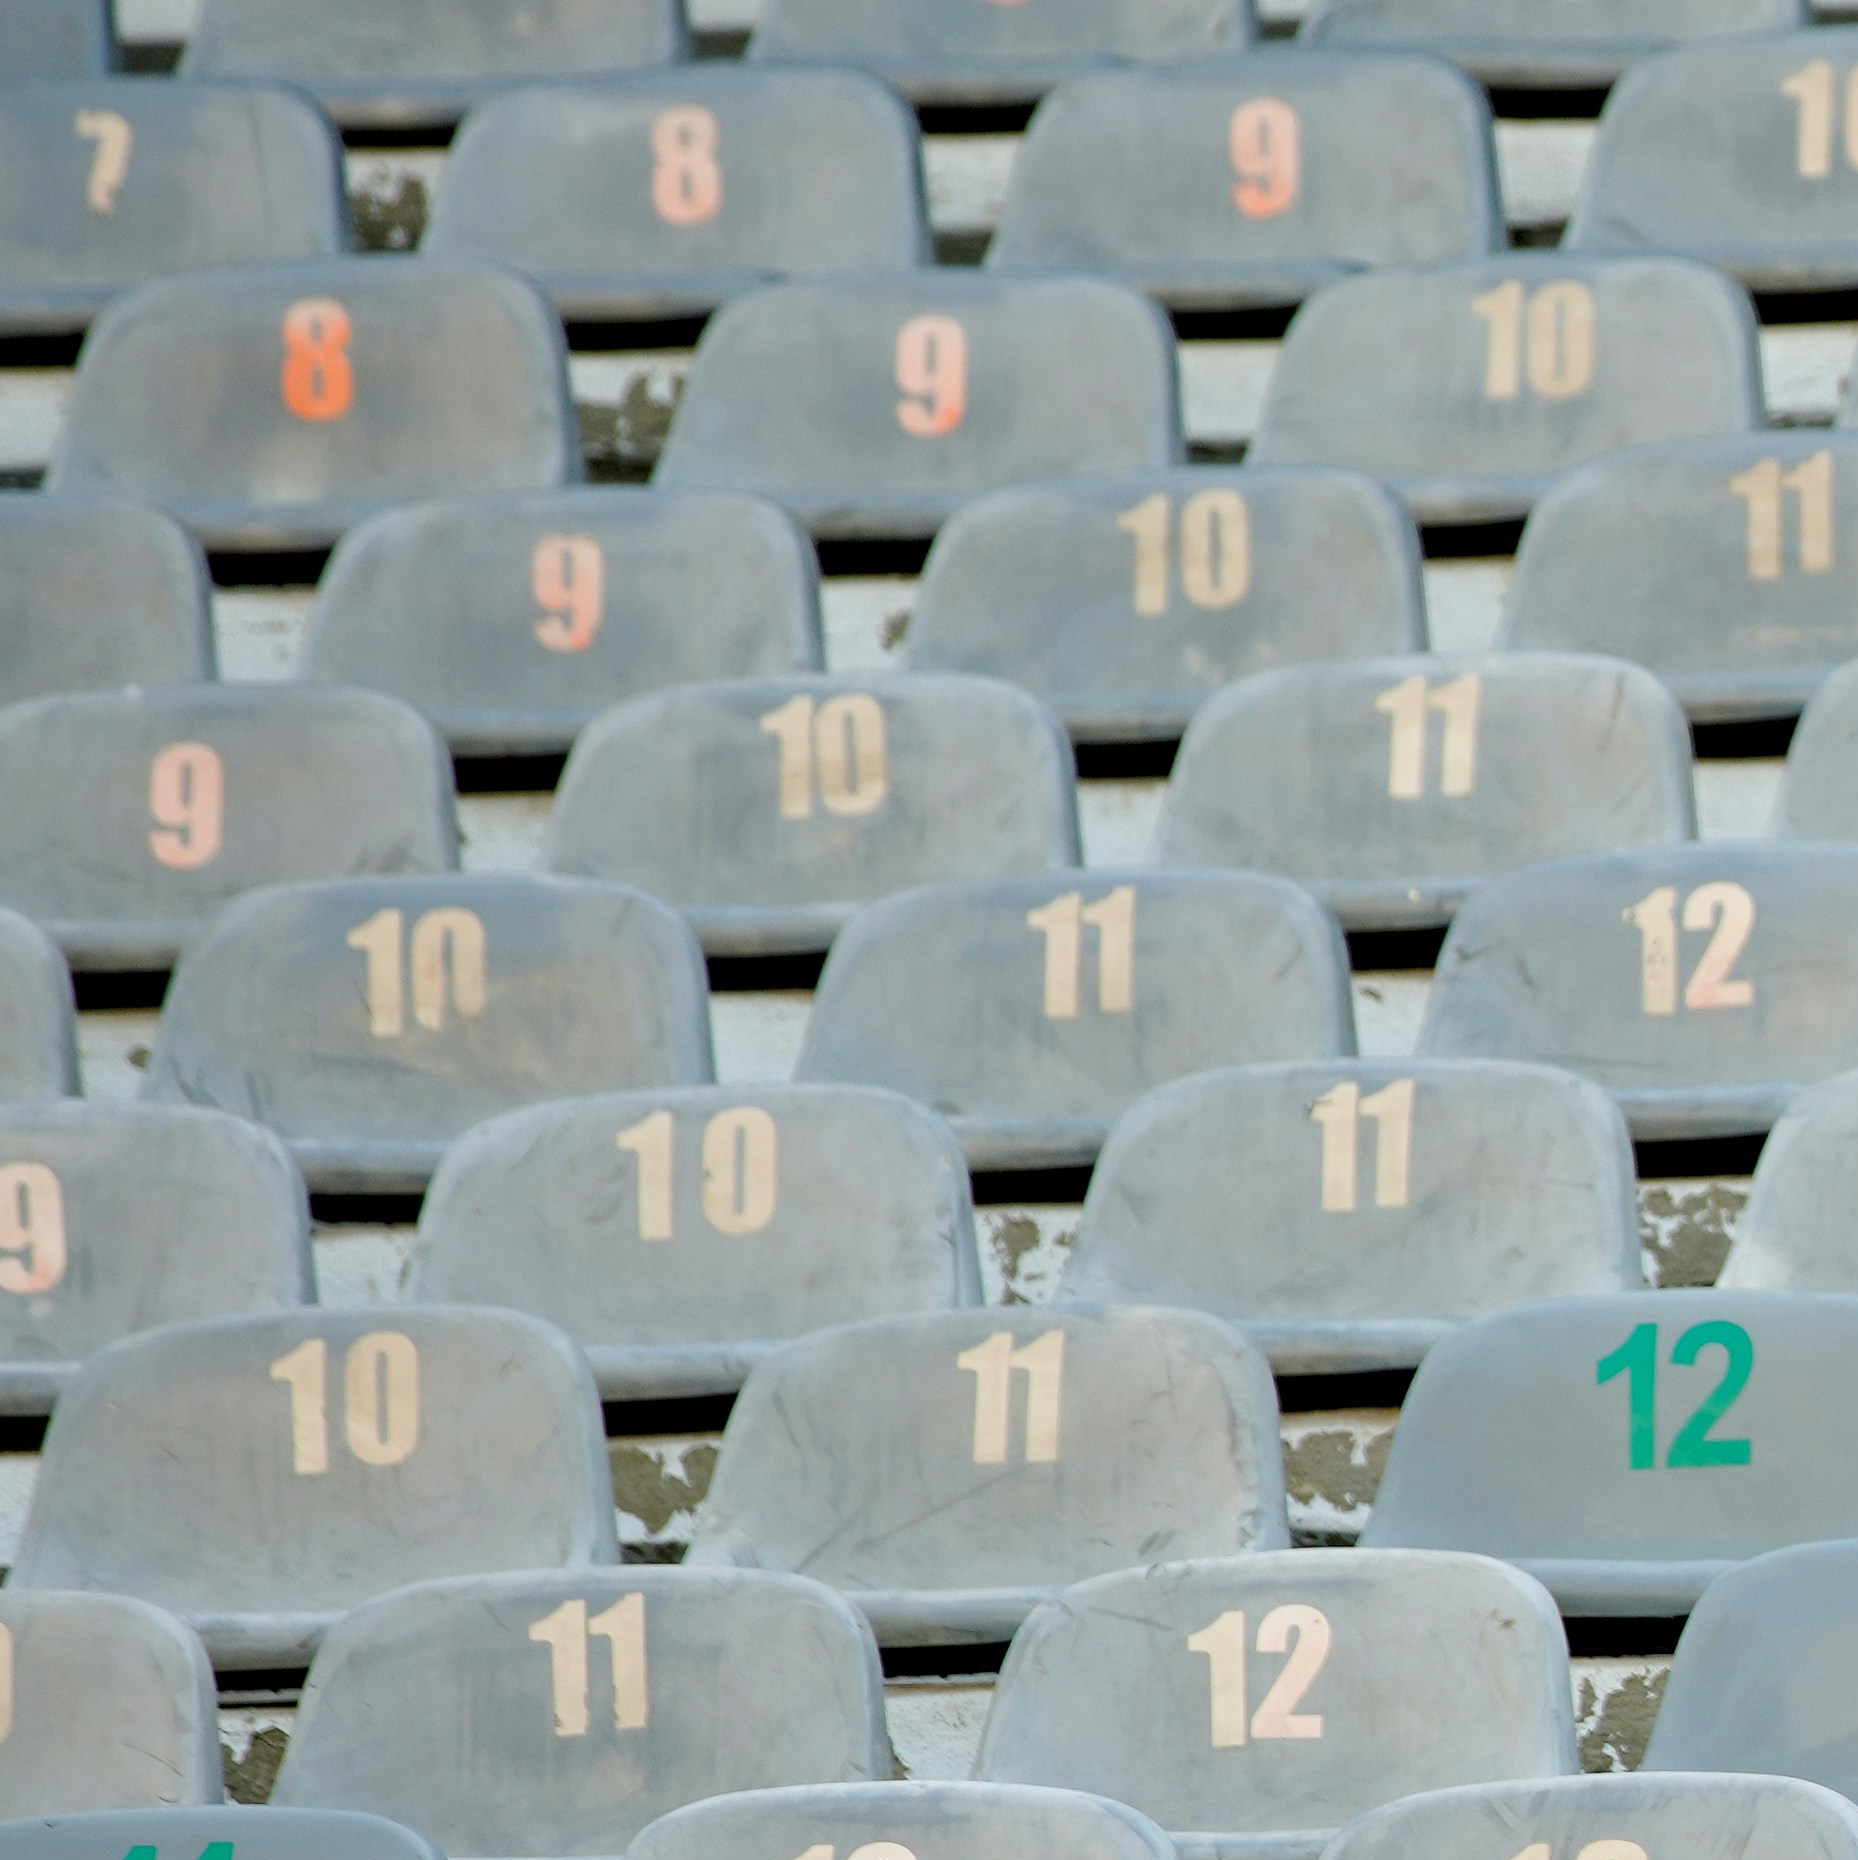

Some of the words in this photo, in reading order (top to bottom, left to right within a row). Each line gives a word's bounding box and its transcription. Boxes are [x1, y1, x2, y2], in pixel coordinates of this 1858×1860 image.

[77, 113, 131, 215] 7
[652, 108, 722, 225] 8
[1230, 101, 1299, 219] 9
[280, 300, 355, 421] 8
[896, 318, 967, 437] 9
[1472, 283, 1596, 399] 10
[1118, 492, 1251, 615] 10
[1729, 454, 1833, 580] 11
[532, 536, 603, 652] 9
[762, 697, 889, 819] 10
[1375, 676, 1482, 799] 11
[149, 743, 224, 868] 9
[349, 910, 488, 1036] 10
[1029, 889, 1134, 1020] 11
[1626, 883, 1754, 1016] 12
[618, 1110, 778, 1240] 10
[1311, 1082, 1413, 1211] 11
[270, 1334, 420, 1473] 10
[956, 1332, 1064, 1465] 11
[1597, 1320, 1754, 1470] 12
[529, 1594, 648, 1737] 11
[1187, 1605, 1331, 1748] 12
